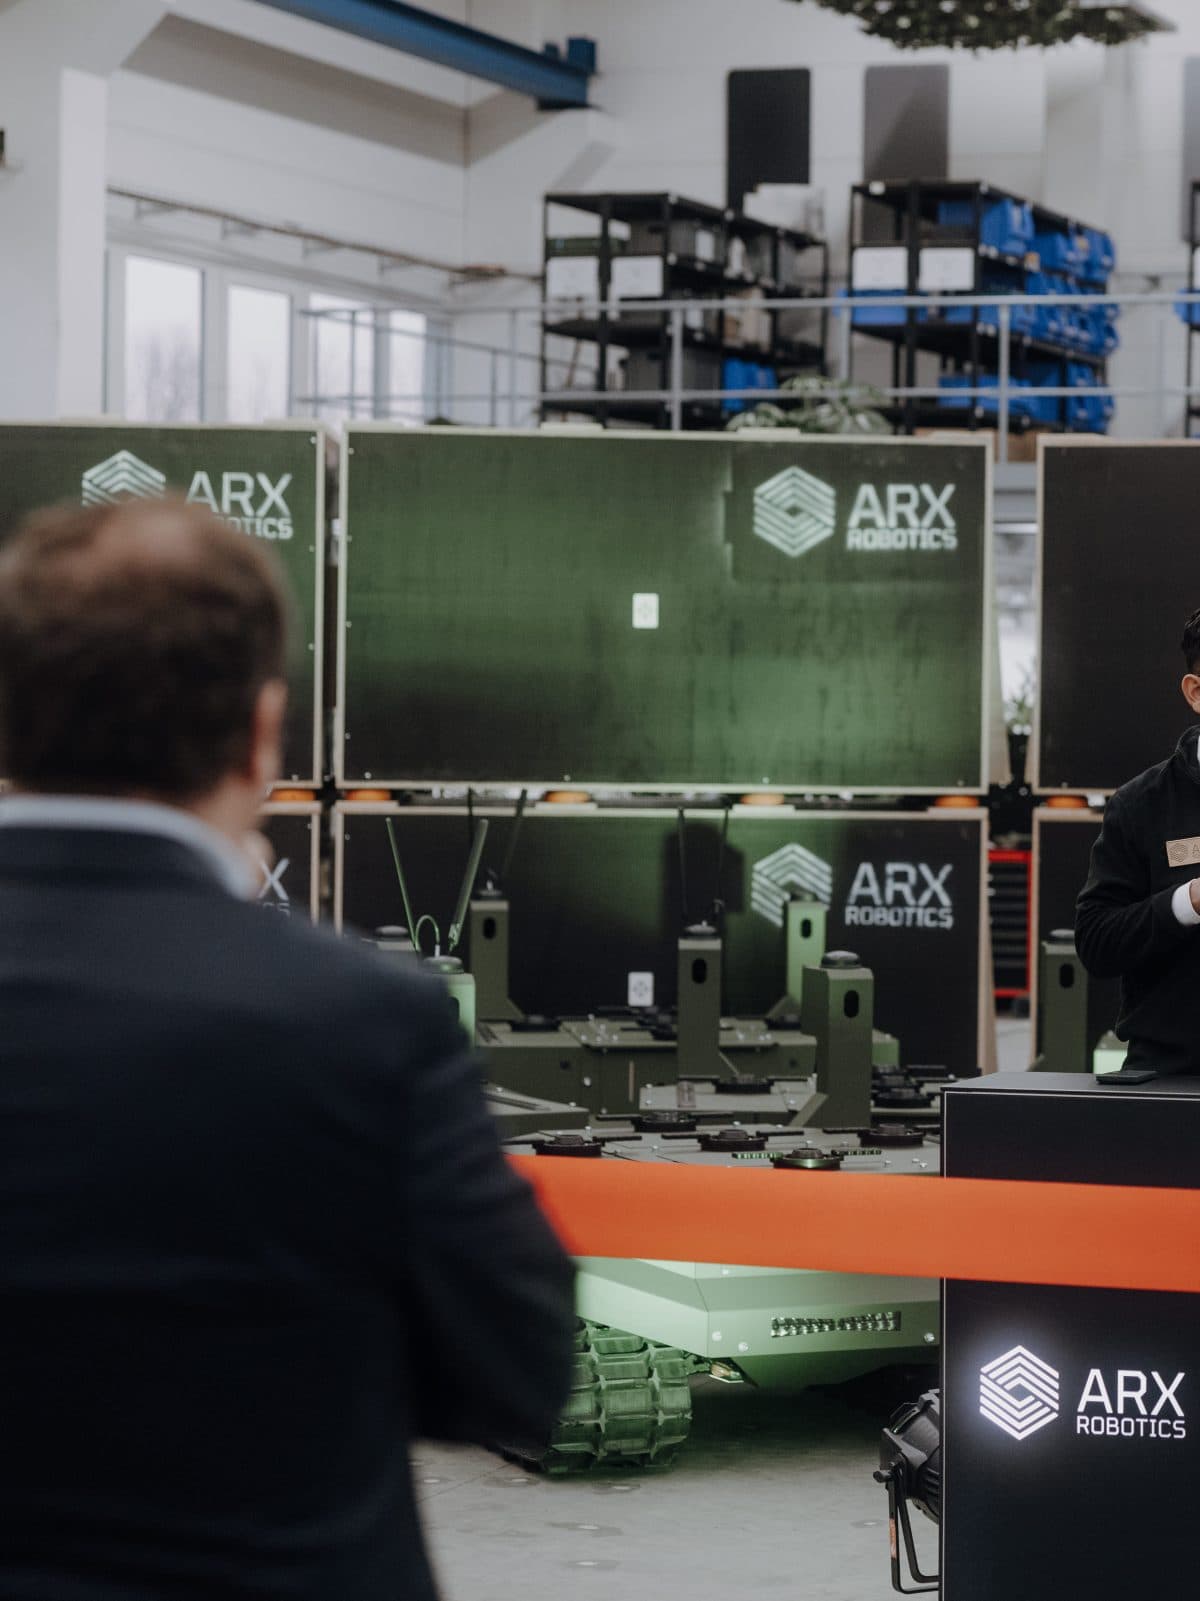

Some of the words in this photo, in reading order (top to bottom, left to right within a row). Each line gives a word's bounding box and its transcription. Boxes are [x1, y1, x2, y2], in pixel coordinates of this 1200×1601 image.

[185, 470, 292, 517] ARX
[847, 484, 956, 529] ARX
[846, 528, 958, 551] ROBOTICS
[848, 861, 953, 906] ARX
[845, 905, 954, 930] ROBOTICS
[1077, 1368, 1185, 1417] ARX
[1076, 1415, 1186, 1439] ROBOTICS
